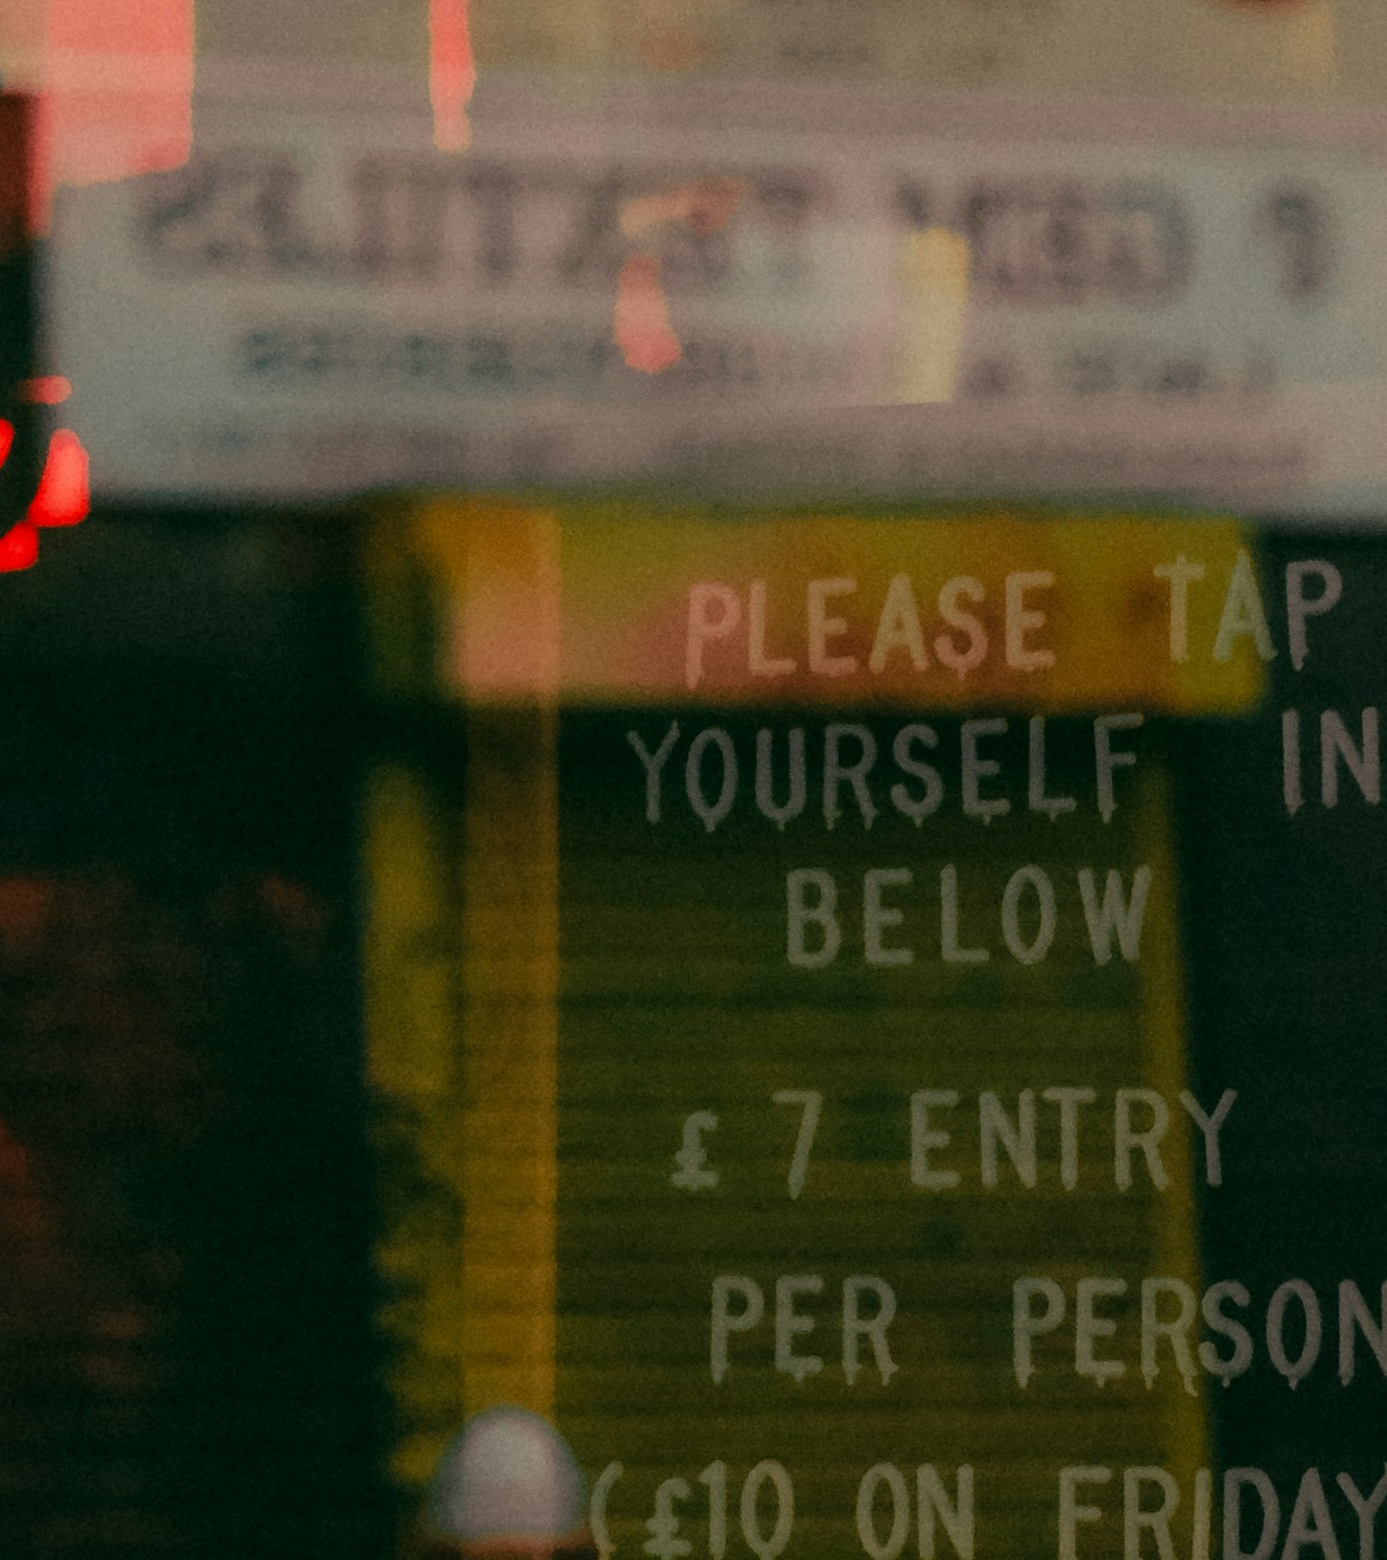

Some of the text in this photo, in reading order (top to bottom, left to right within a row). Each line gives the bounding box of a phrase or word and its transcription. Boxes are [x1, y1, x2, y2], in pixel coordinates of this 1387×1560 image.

[683, 548, 1344, 688] PLEASE TAP
[626, 707, 1381, 831] YOURSELF IN
[784, 866, 1152, 969] BELOW
[908, 1084, 1239, 1191] ENTRY
[711, 1275, 1387, 1394] PER PERSON
